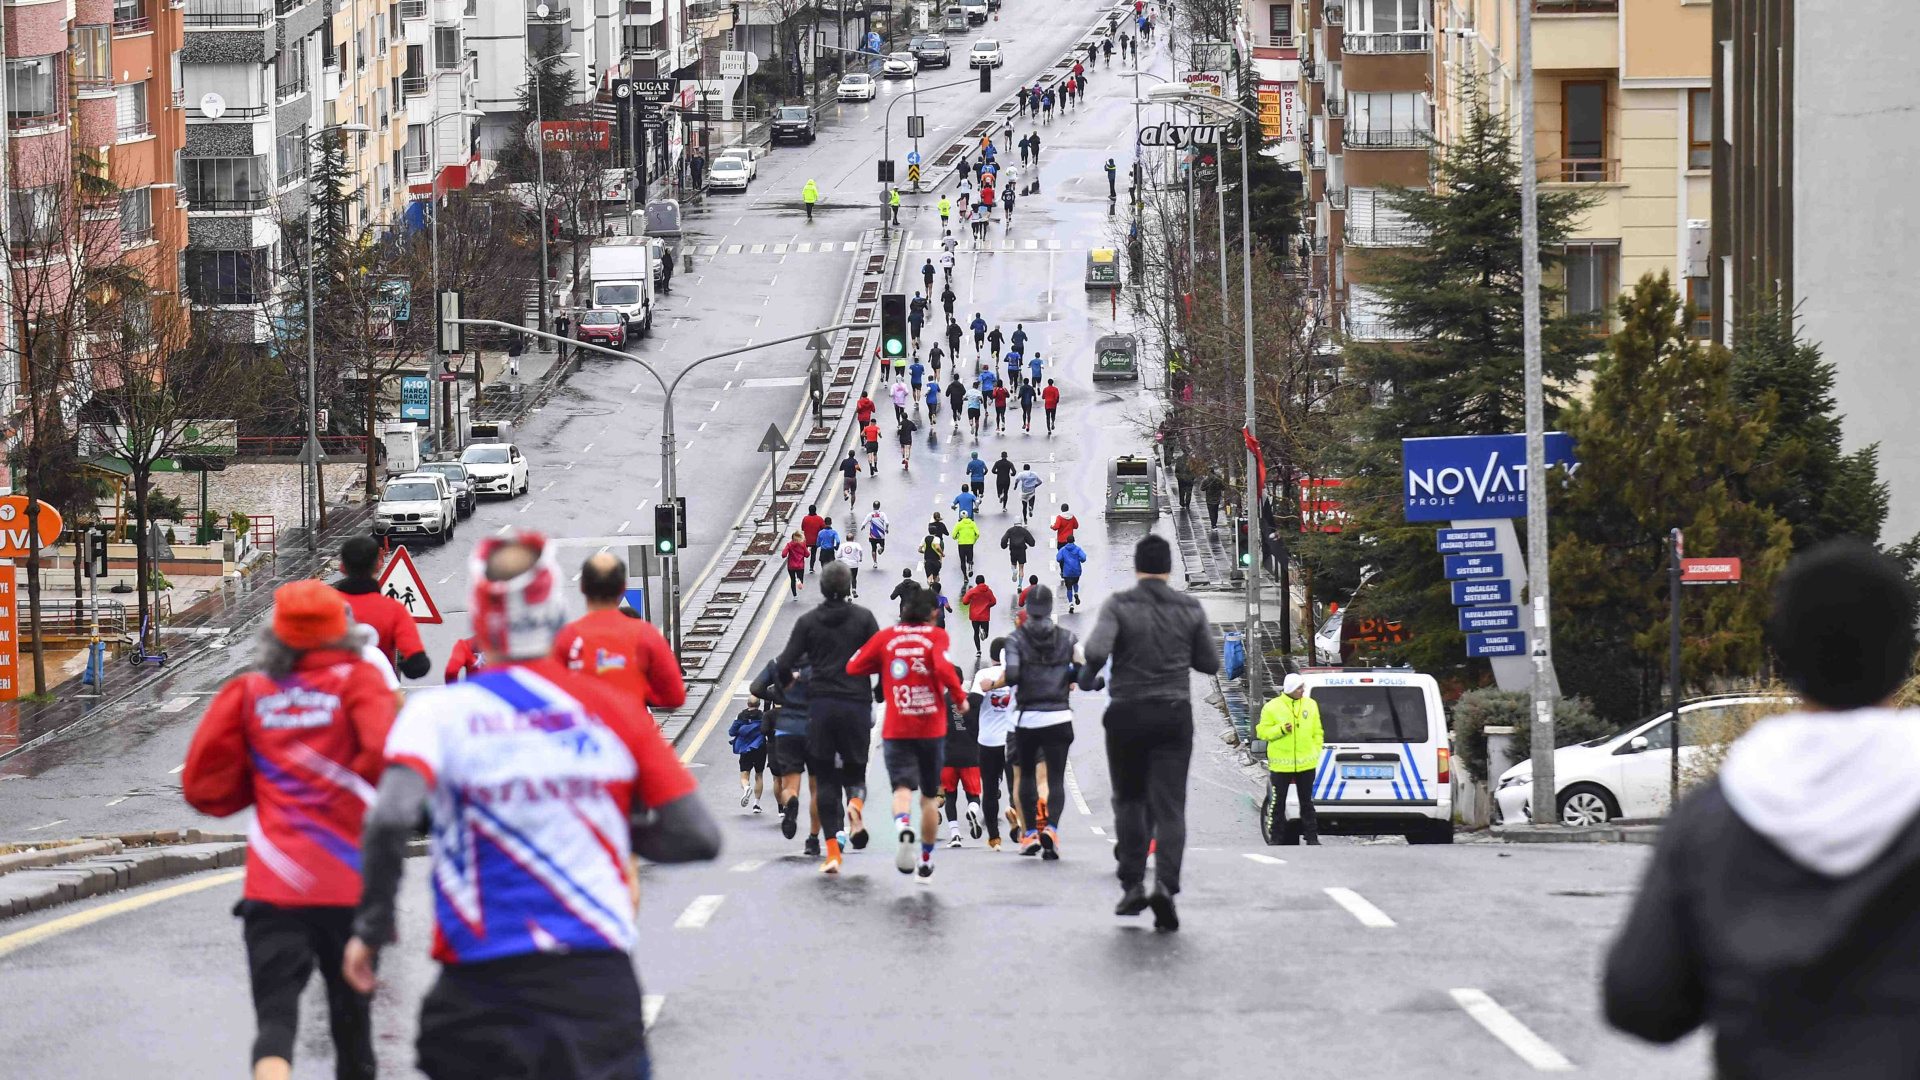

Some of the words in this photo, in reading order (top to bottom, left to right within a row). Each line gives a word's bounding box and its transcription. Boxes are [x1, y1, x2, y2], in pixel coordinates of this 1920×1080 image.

[632, 81, 671, 91] SUGAR
[1261, 104, 1278, 112] ANYO
[1284, 91, 1294, 135] MOBİLYA
[1408, 451, 1582, 504] NOVATK
[1409, 498, 1455, 506] PROJE
[1465, 584, 1499, 593] DOĞALGAZ
[1464, 593, 1501, 602] SİSTEMLERİ
[1471, 618, 1508, 627] SİSTEMLERİ
[1479, 644, 1516, 653] SİSTEMLERİ
